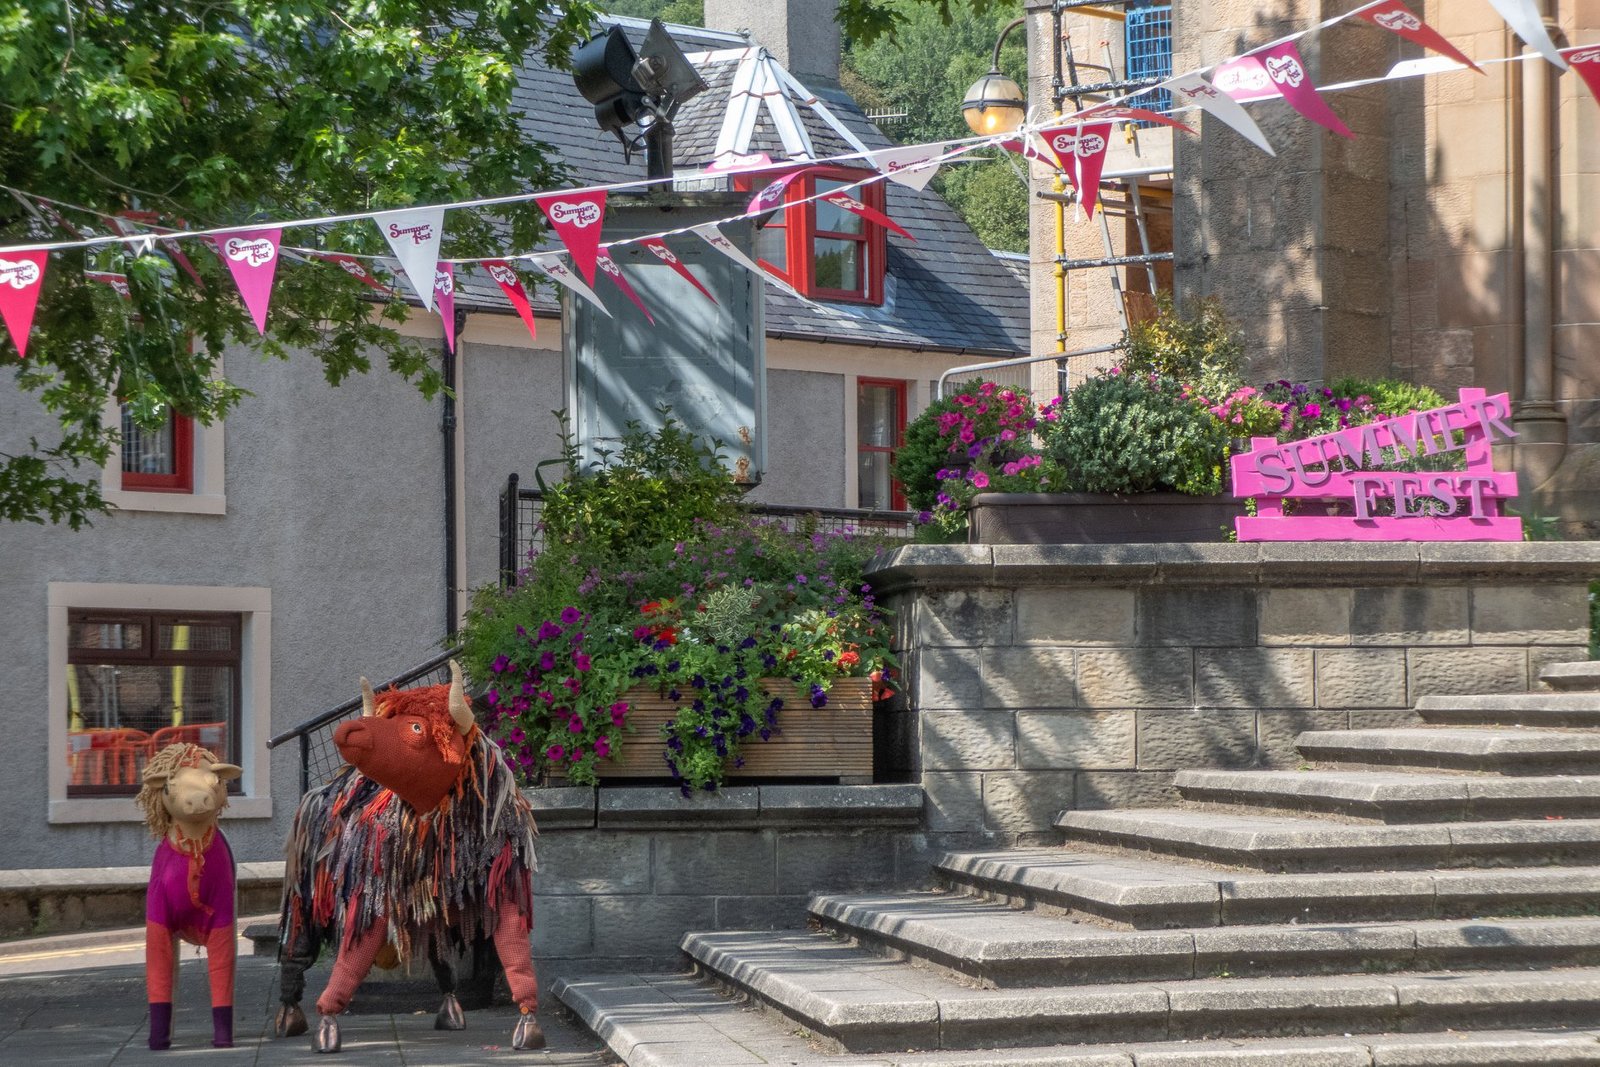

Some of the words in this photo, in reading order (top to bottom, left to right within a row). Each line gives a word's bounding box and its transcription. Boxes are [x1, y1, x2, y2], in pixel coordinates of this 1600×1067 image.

[554, 204, 594, 218] Summer
[389, 223, 430, 238] Summer
[229, 241, 269, 255] Summer
[0, 264, 33, 275] ummer
[1255, 399, 1520, 495] SUMMER
[1349, 476, 1495, 521] FEST
